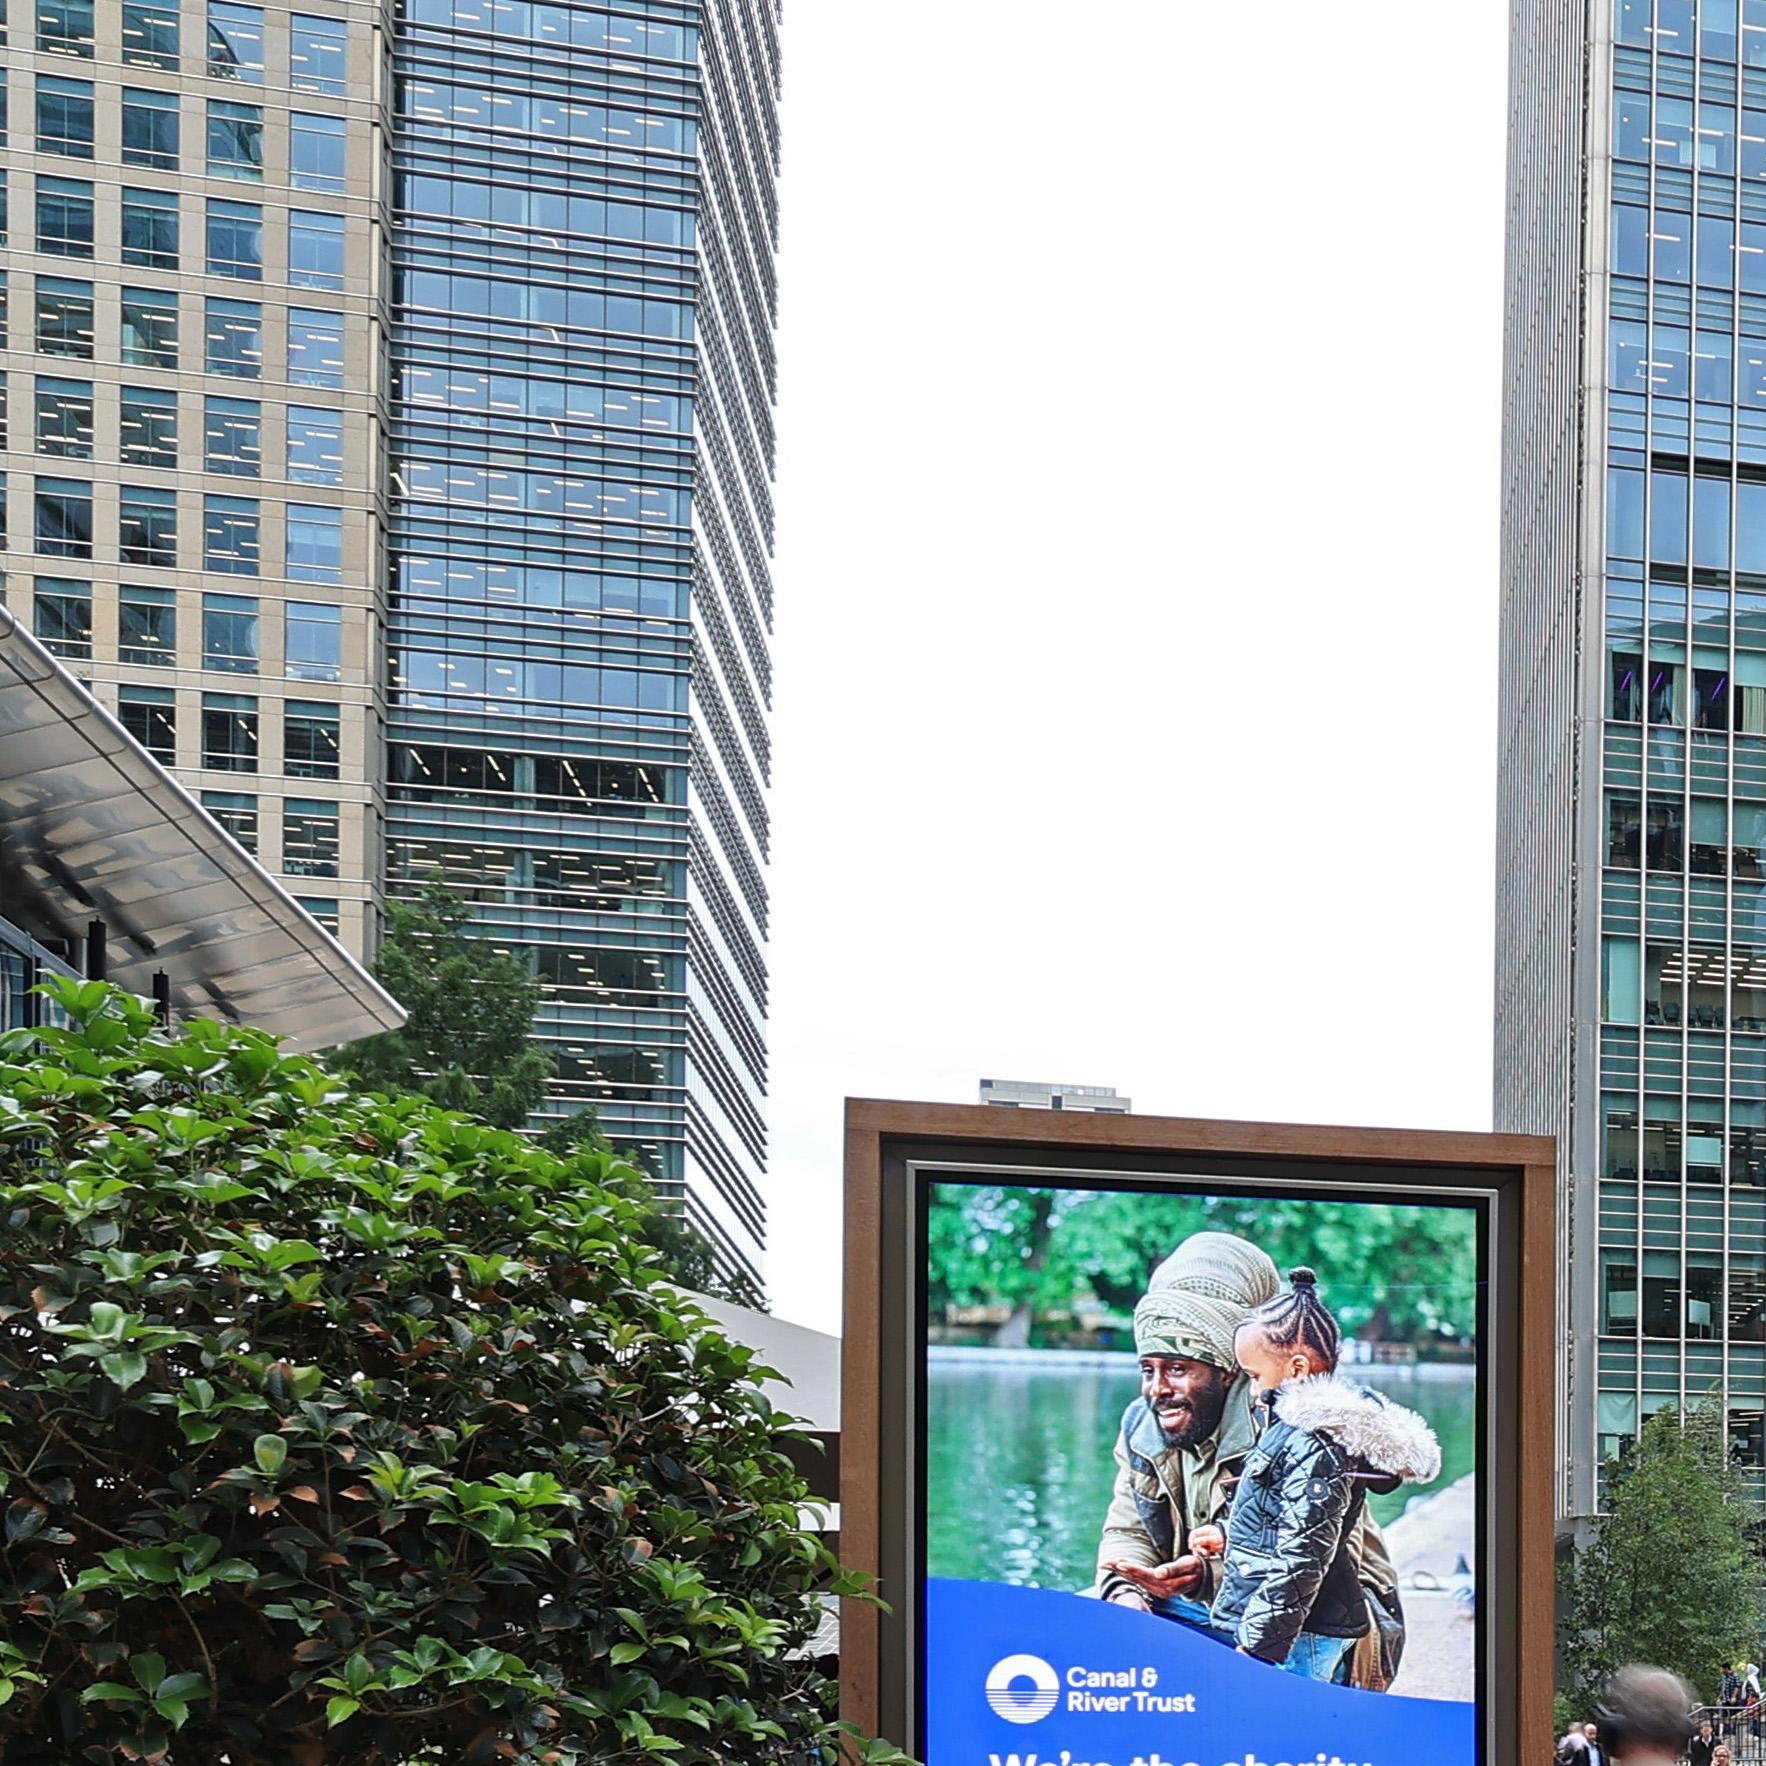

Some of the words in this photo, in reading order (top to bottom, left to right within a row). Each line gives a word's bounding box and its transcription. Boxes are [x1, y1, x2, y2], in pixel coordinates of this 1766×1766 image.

[1067, 1667, 1136, 1687] Canal
[1142, 1667, 1158, 1688] &
[1068, 1691, 1131, 1712] River
[1133, 1691, 1195, 1712] Trust
